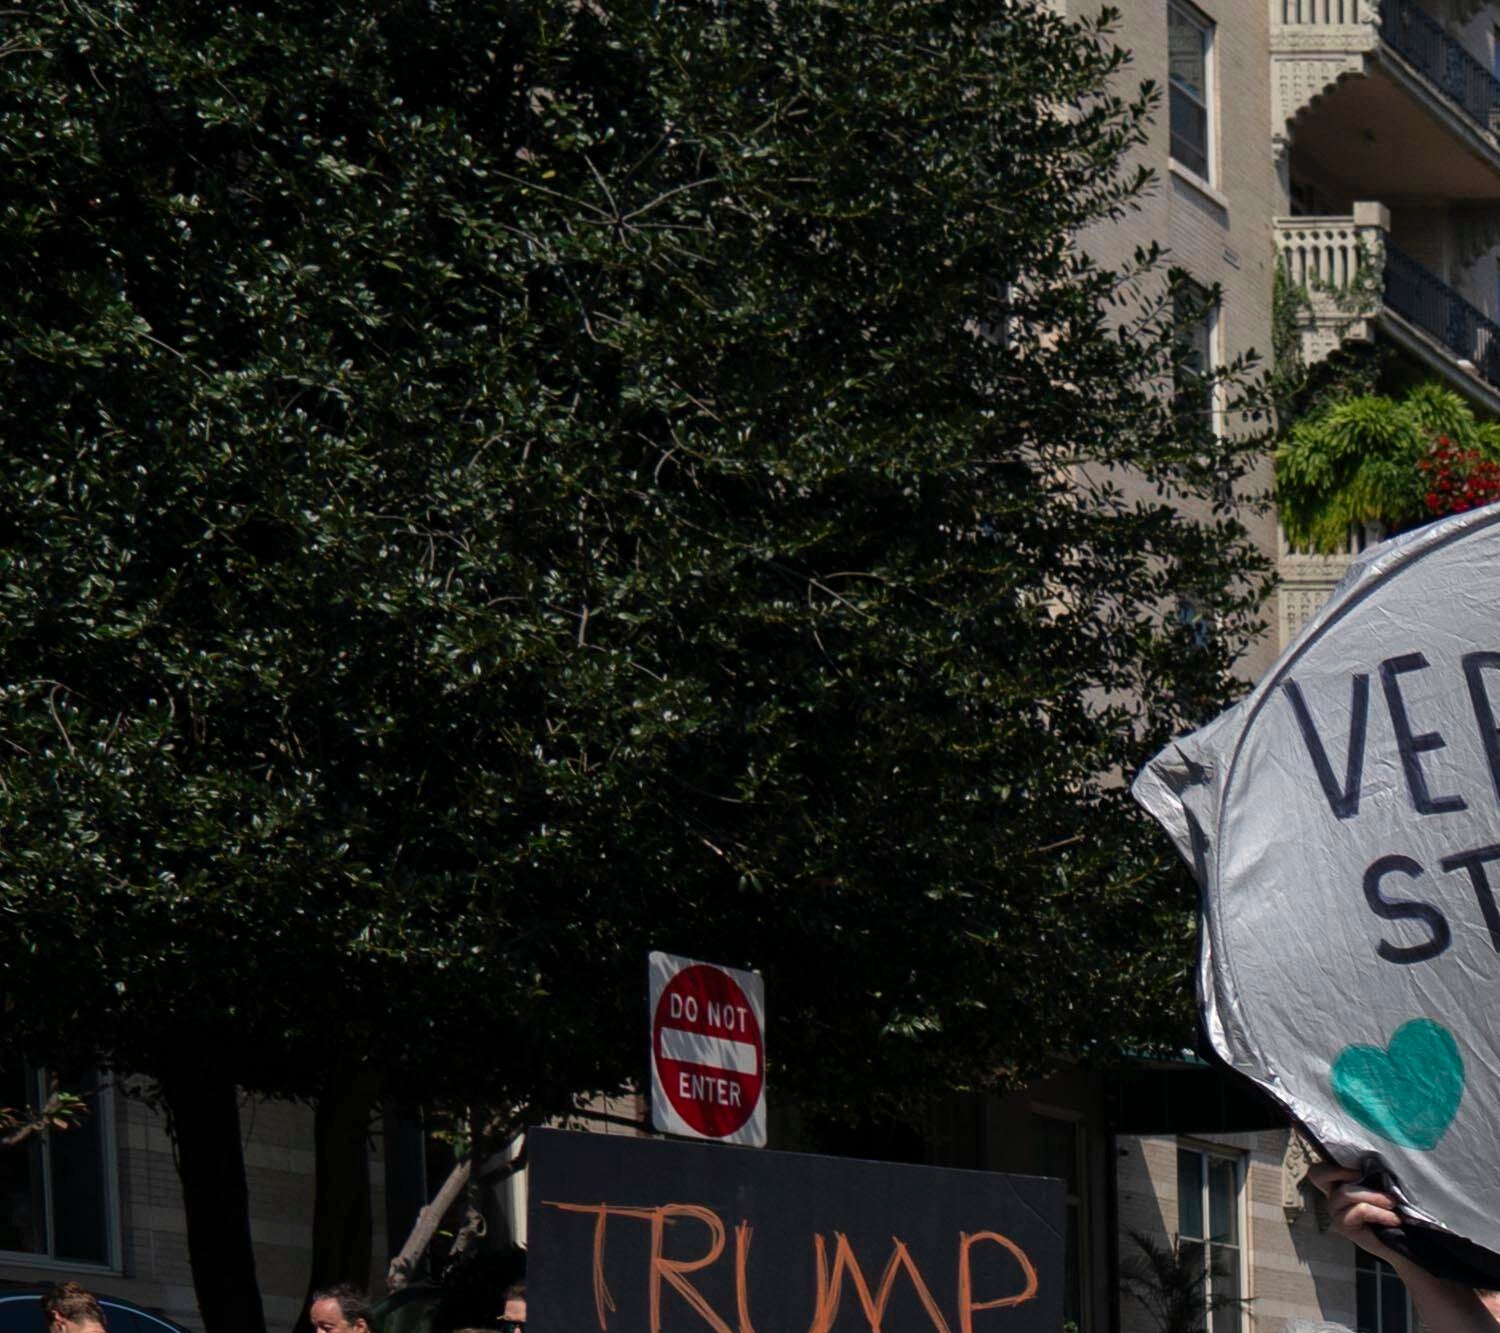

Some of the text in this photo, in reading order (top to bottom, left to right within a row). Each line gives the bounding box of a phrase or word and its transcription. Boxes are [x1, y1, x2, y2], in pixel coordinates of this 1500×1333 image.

[671, 993, 747, 1033] DO NOT
[679, 1072, 741, 1107] ENTER
